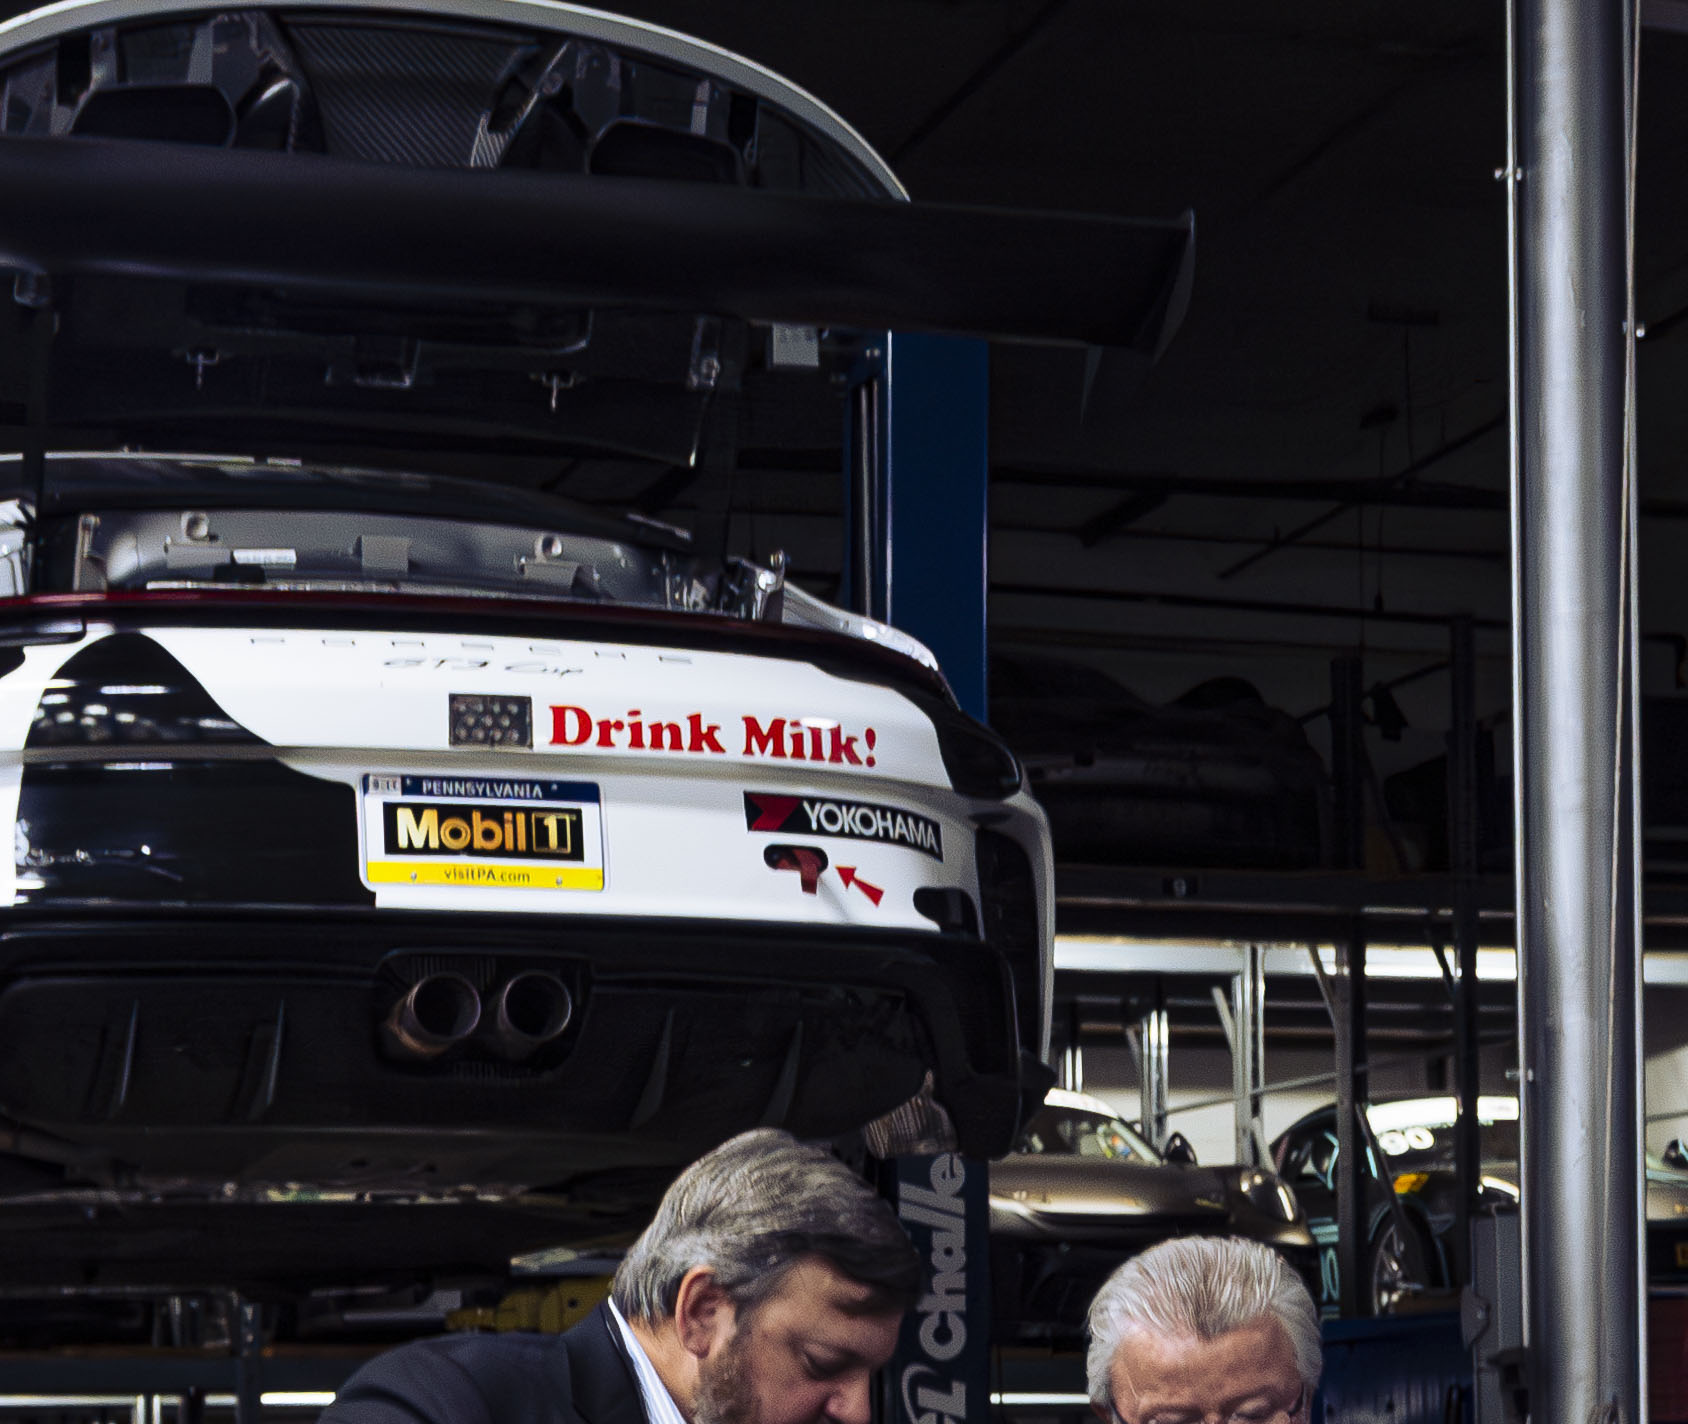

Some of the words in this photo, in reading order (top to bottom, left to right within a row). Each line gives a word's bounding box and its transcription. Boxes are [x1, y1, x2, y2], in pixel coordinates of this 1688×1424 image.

[549, 704, 726, 754] Drink
[742, 714, 876, 769] Milk!
[422, 779, 543, 799] PENNSYLVANIA
[396, 807, 526, 851] Mobil
[803, 800, 939, 853] YOKOHAMA
[899, 1152, 967, 1361] Challe
